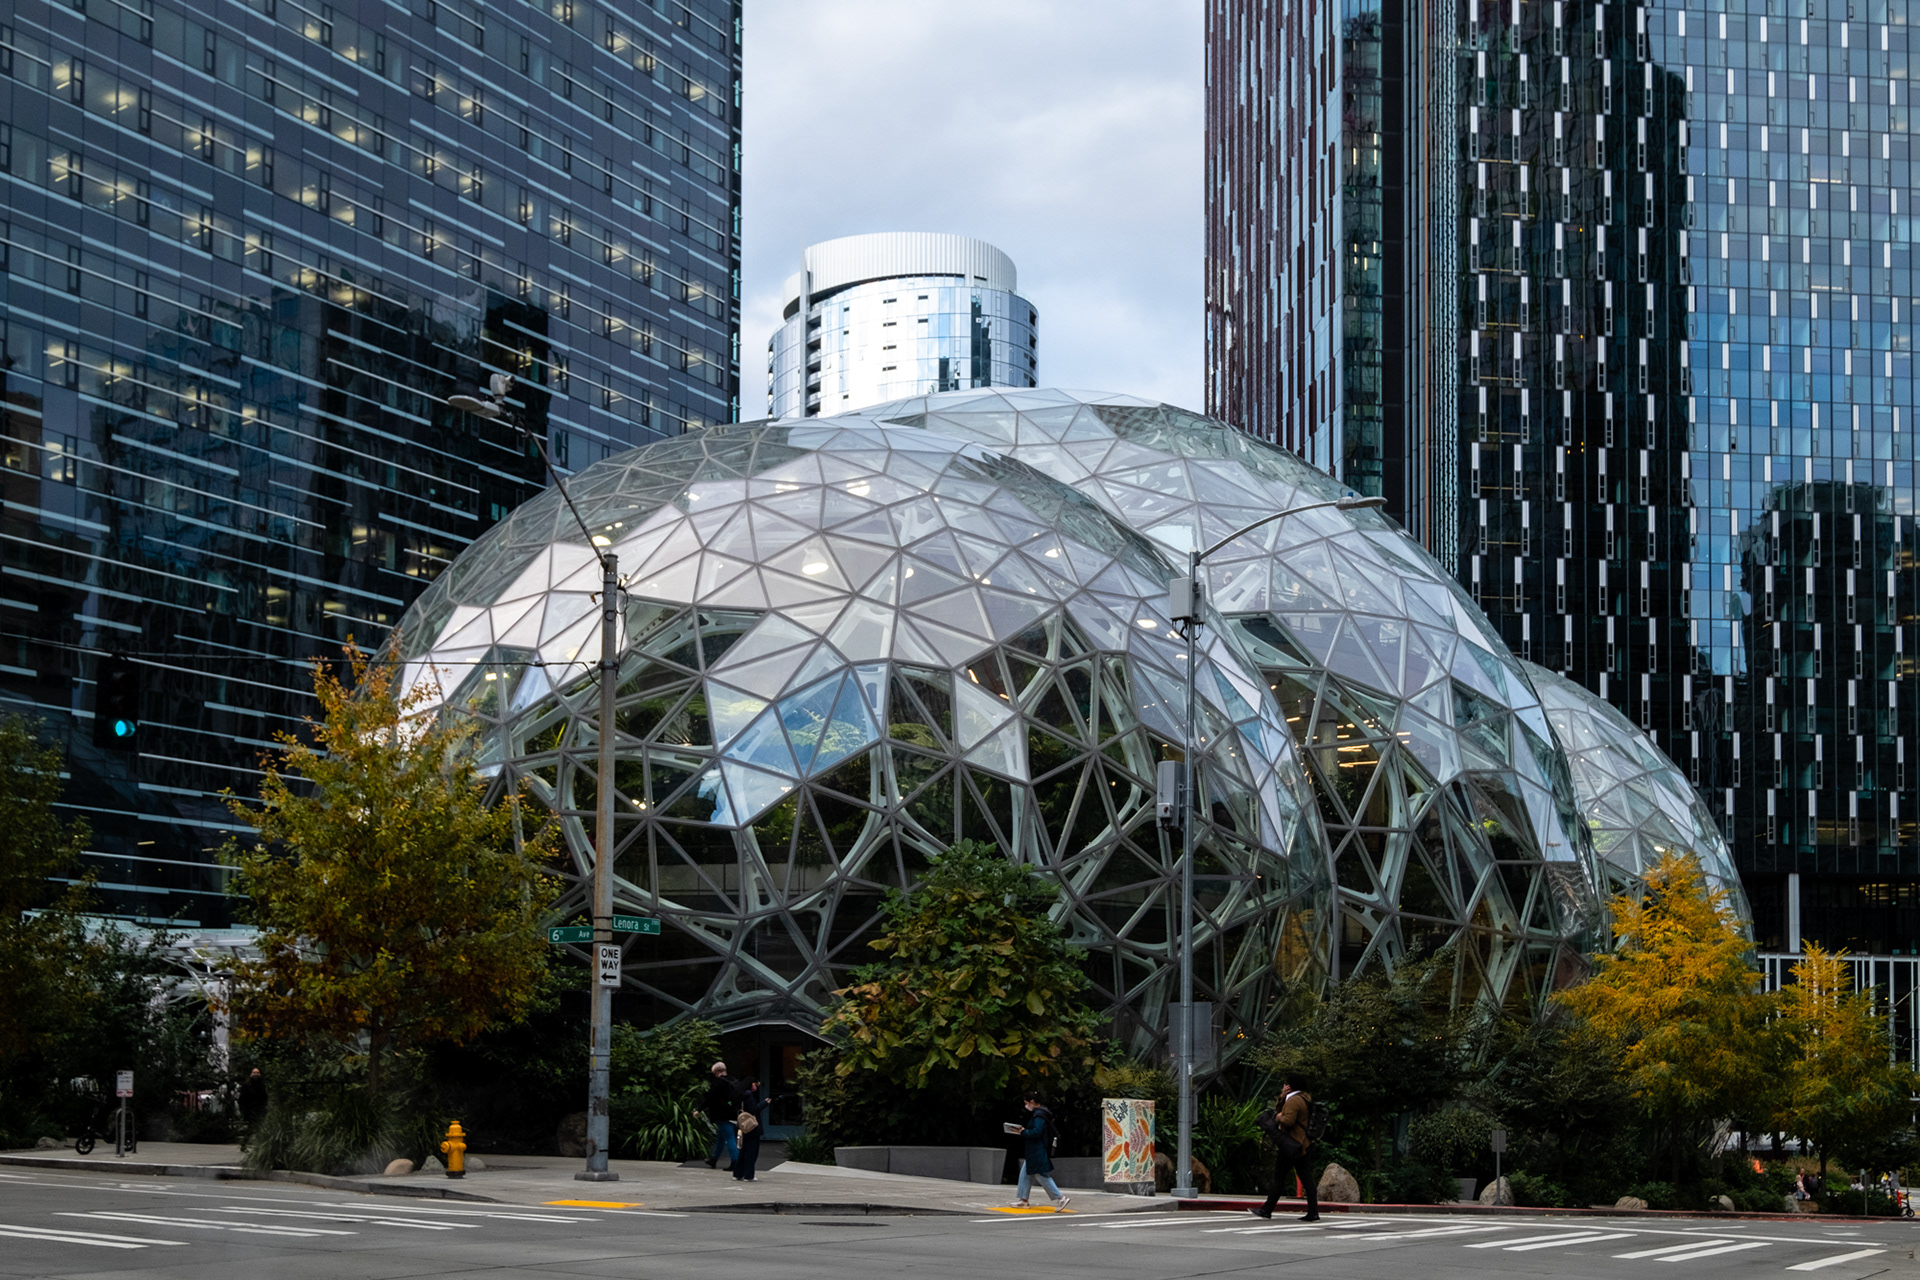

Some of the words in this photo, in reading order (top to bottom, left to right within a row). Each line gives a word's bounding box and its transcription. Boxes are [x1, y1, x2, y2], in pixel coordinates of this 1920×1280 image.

[613, 916, 639, 930] Lenora
[643, 922, 650, 931] St
[579, 930, 590, 938] Ave
[601, 948, 618, 959] ONE
[601, 959, 619, 970] WAY
